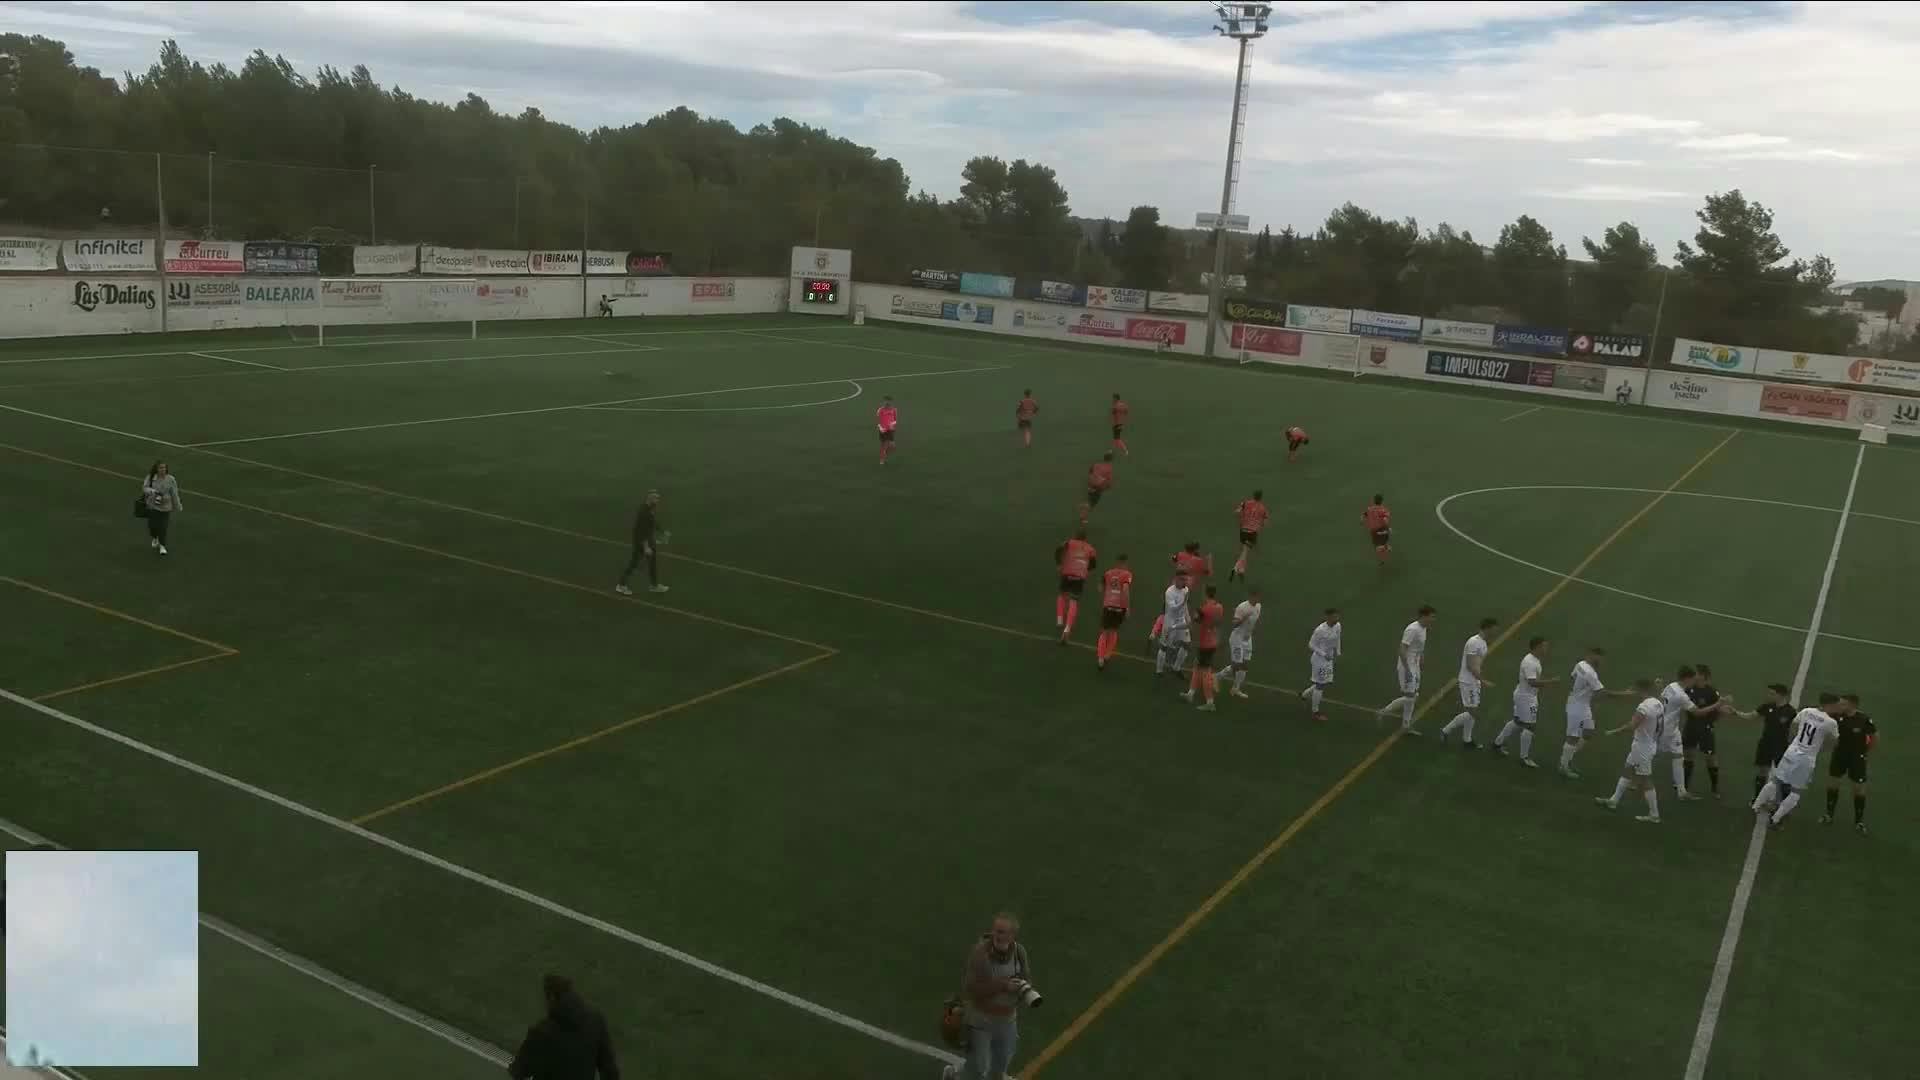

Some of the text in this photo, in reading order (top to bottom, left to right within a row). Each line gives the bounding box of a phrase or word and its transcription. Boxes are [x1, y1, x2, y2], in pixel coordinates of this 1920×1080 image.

[543, 253, 579, 264] IBIRAMA
[71, 280, 156, 312] Las Dalias
[1592, 342, 1642, 357] PALAU
[1444, 355, 1510, 379] IMPULSO27
[1799, 722, 1817, 745] 14
